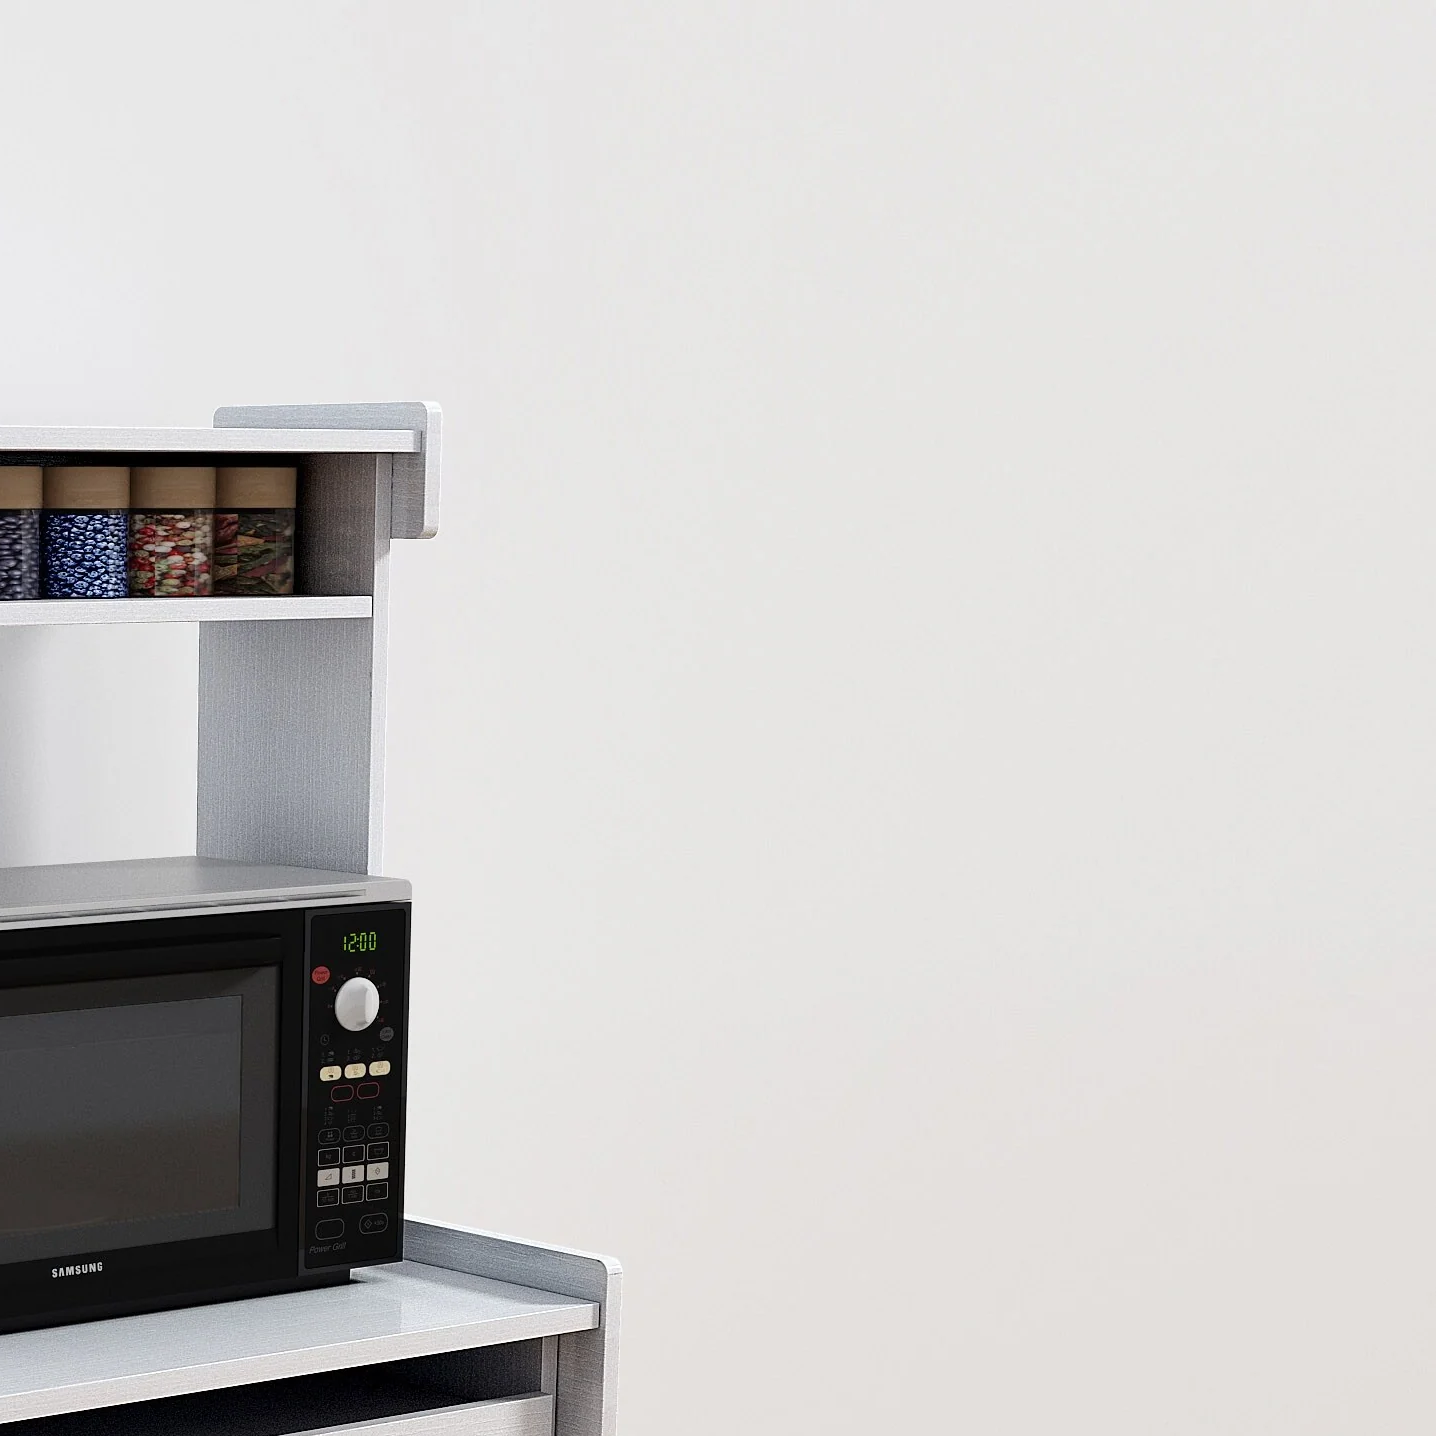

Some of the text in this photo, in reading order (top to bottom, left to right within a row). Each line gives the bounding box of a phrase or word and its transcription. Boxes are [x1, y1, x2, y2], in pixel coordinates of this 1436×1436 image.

[344, 932, 377, 952] 12:00
[309, 1241, 347, 1254] Power Grill
[52, 1262, 103, 1278] SAMSUNG
